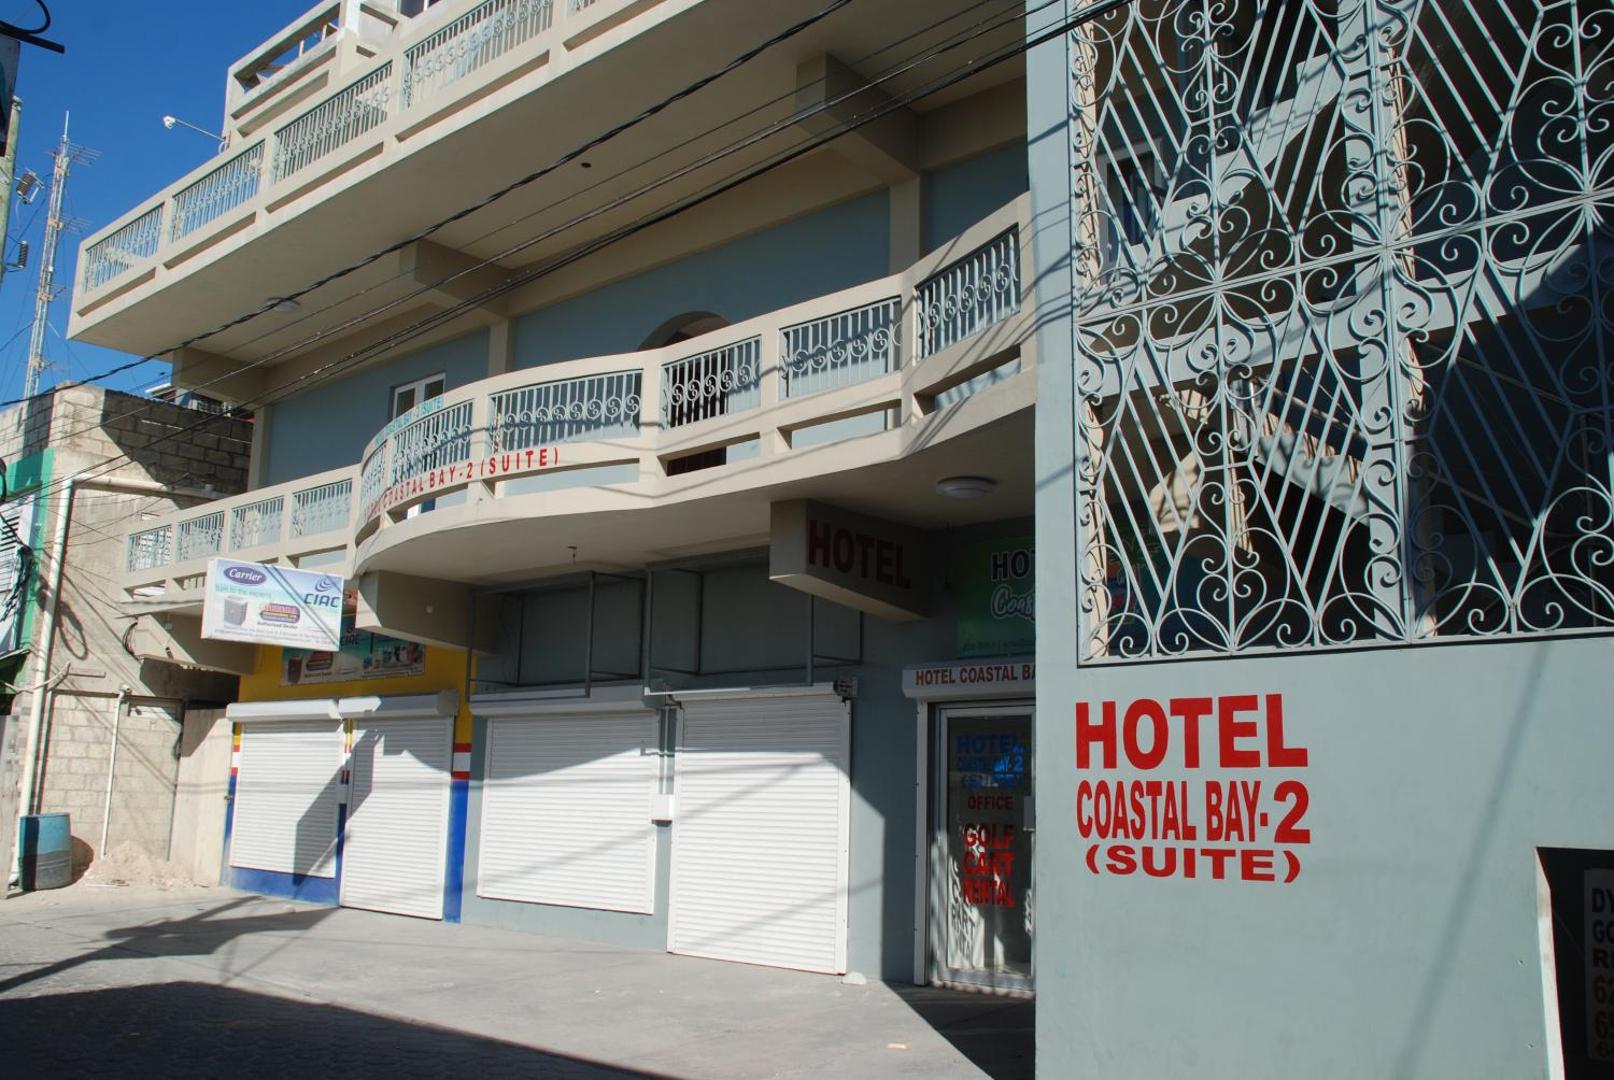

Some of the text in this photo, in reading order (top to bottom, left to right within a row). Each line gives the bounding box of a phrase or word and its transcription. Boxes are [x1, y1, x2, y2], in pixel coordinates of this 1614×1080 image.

[429, 462, 473, 488] BAY-2
[480, 447, 559, 477] (SUITE)
[809, 519, 911, 590] HOTEL
[229, 568, 263, 582] Carrier
[303, 593, 341, 608] CIAC
[916, 668, 955, 686] HOTEL
[960, 664, 1018, 684] COASTAL
[1075, 693, 1309, 770] HOTEL
[967, 795, 1014, 810] OFFICE
[1076, 779, 1311, 844] COASTAL BAY-2
[963, 823, 1014, 848] GOLF
[963, 851, 1014, 875] CART
[1085, 844, 1301, 884] (SUITE)
[1592, 948, 1614, 969] R
